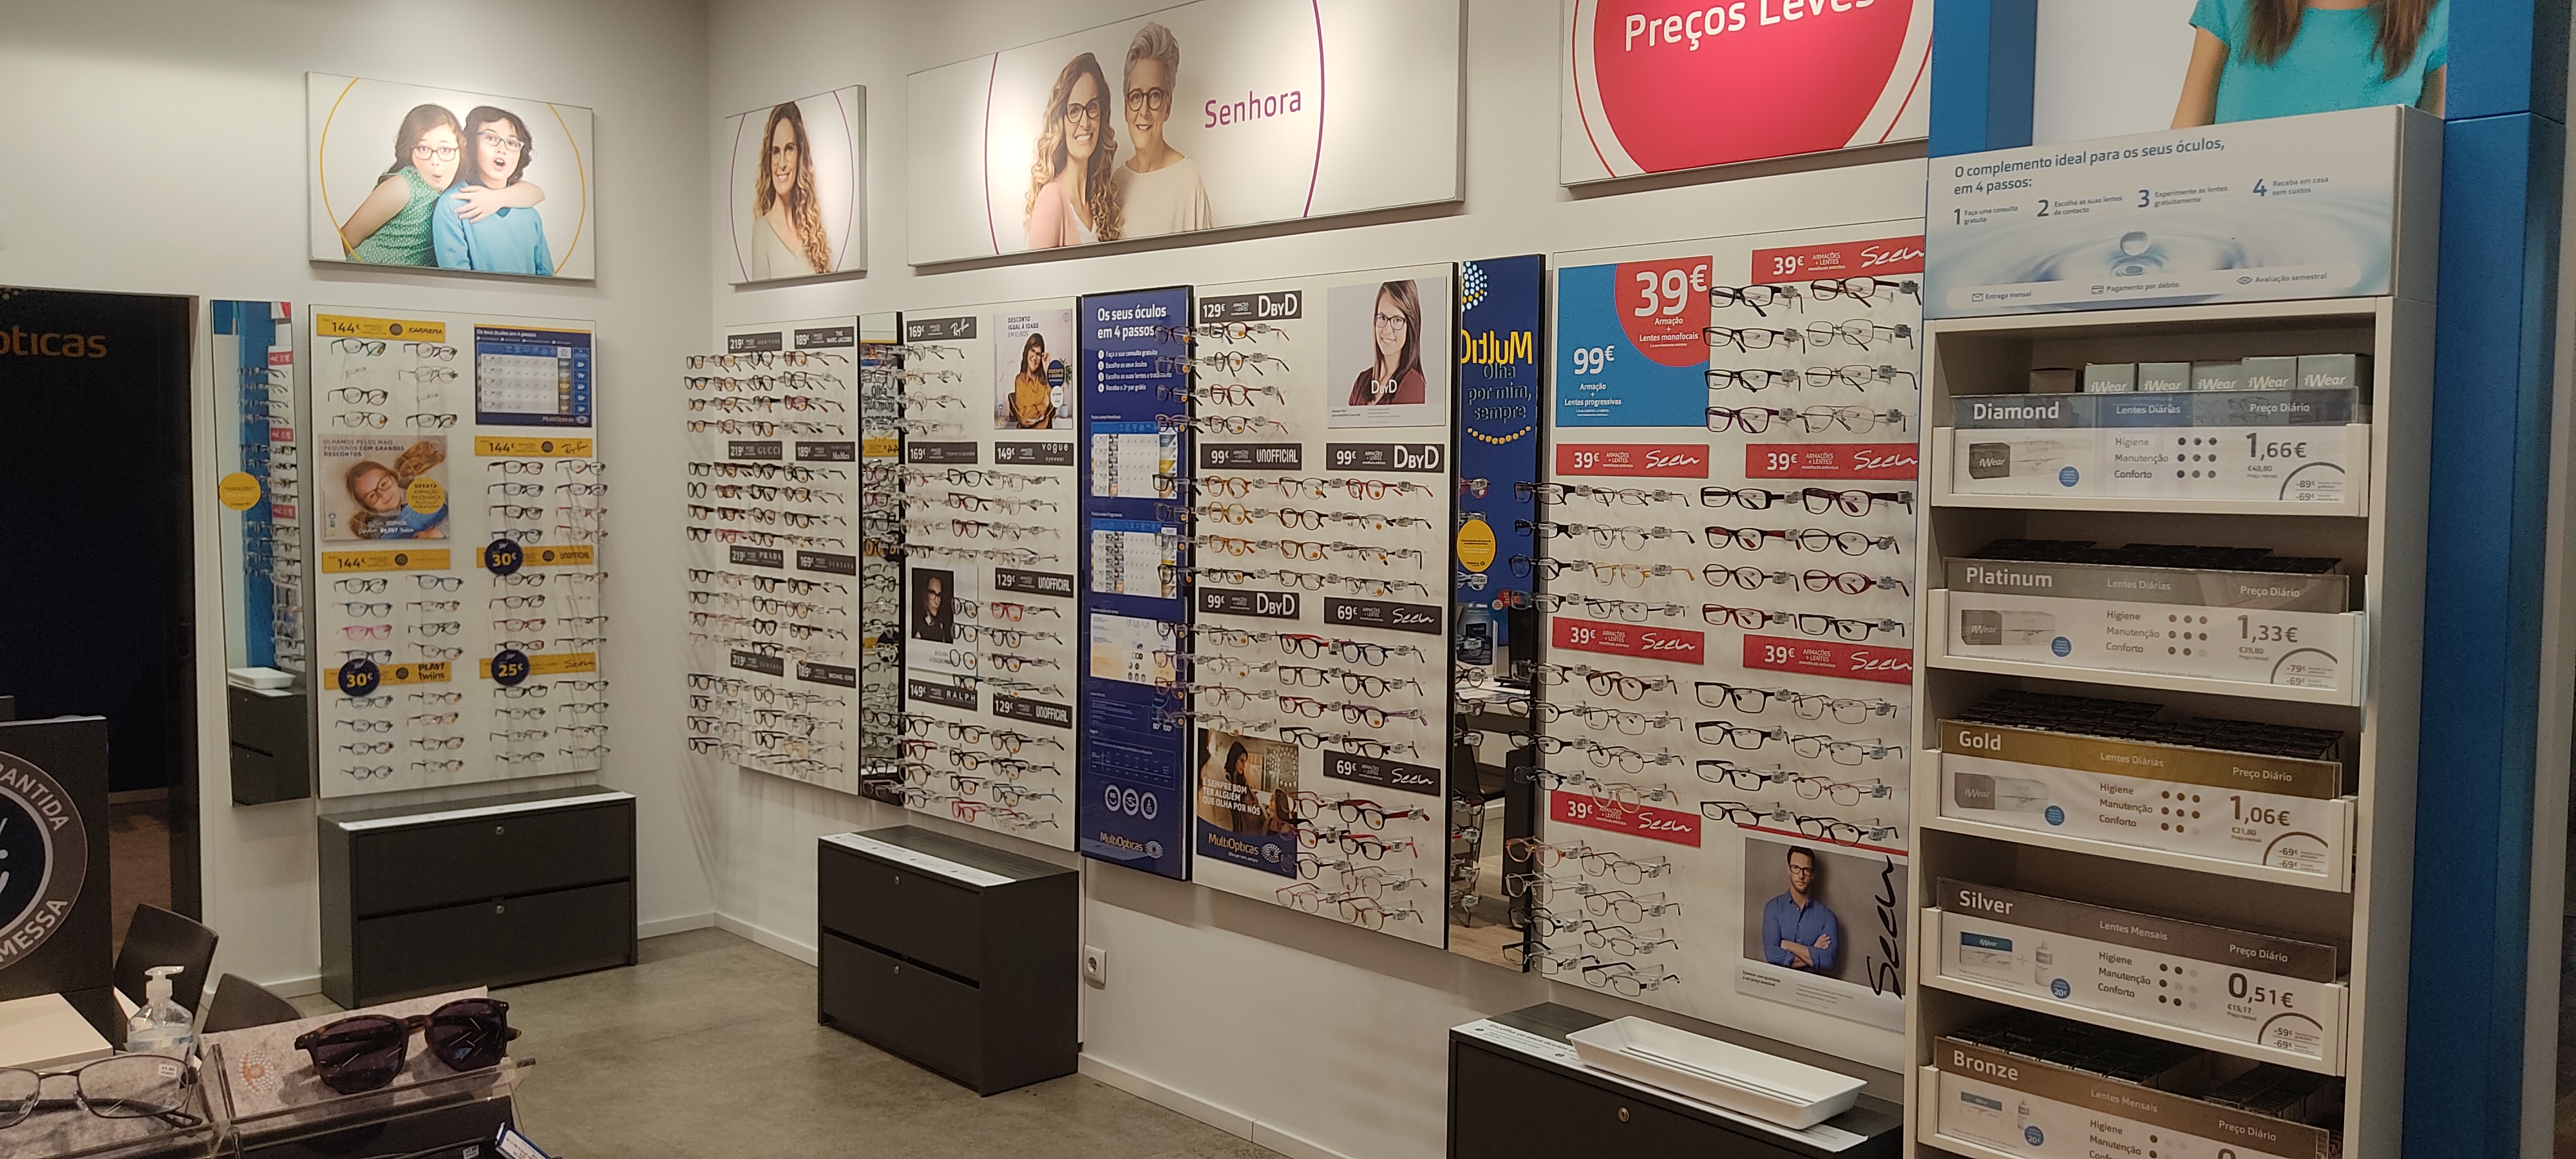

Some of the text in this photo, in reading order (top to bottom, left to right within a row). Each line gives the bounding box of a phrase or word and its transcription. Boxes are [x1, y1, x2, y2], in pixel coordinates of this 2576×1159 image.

[1625, 0, 1875, 52] Preços Lev
[1204, 90, 1302, 128] Senhora
[1955, 137, 2225, 178] O complemento ideal para os seus óculos,
[1954, 178, 2032, 194] em 4 passos:
[2155, 188, 2197, 198] Experimente
[2253, 178, 2267, 196] 4
[2138, 189, 2150, 207] 3
[2154, 196, 2201, 207] gratuitamente
[1953, 208, 1961, 225] 1
[2037, 199, 2049, 217] 2
[1964, 217, 1986, 225] gratuita
[1773, 256, 1804, 275] 39€
[2255, 272, 2327, 285] Avaliação semestral
[1634, 265, 1707, 317] 39€
[2107, 284, 2143, 293] Pagamento
[1097, 303, 1167, 321] Os seus óculos
[1203, 303, 1226, 318] 129€
[1654, 317, 1683, 326] Armação
[1097, 328, 1112, 339] em
[1114, 325, 1121, 338] 4
[1639, 332, 1698, 342] Lentes monofocais
[1573, 345, 1615, 375] 99€
[1580, 383, 1606, 391] Armação
[2144, 380, 2182, 391] iWear
[2198, 379, 2238, 390] iWear
[2248, 377, 2289, 388] iWear
[2304, 374, 2346, 386] iWear
[1468, 381, 1531, 406] por mim,
[1585, 398, 1622, 407] progressivas
[1973, 401, 2060, 420] Diamond
[2116, 404, 2181, 415] Lentes Diárias
[2250, 402, 2310, 415] Preço Diário
[1474, 406, 1526, 424] sempre
[2116, 438, 2149, 448] Higiene
[2246, 433, 2307, 461] 1,66€
[1211, 448, 1298, 464] 99€ UNOFFICIAL
[1336, 451, 1357, 465] 99€
[1574, 451, 1600, 468] 39€
[1767, 453, 1797, 471] 39€
[1979, 457, 2005, 467] iWear
[2115, 454, 2168, 464] Manutenção
[2114, 470, 2152, 479] Conforto
[1966, 567, 2053, 587] Platinum
[1338, 606, 1358, 621] 69€
[1570, 627, 1596, 644] 39€
[2237, 615, 2298, 644] 1,33€
[1765, 645, 1795, 664] 39€
[947, 690, 976, 702] RALPH
[1959, 730, 2002, 751] Gold
[2101, 752, 2164, 768] Lentes Diárias
[2233, 766, 2292, 782] Preço Diário
[1203, 787, 1241, 802] TER ALGUÉM
[1208, 779, 1232, 791] SEMPRE
[1233, 784, 1247, 795] BOM
[1202, 796, 1261, 816] QUE OLHA POR NÓS
[1567, 800, 1593, 819] 39€
[2230, 795, 2290, 826] 1,06€
[1208, 833, 1259, 855] MultiOpticas
[1959, 890, 2014, 915] Silver
[2099, 920, 2168, 940] Lentes Mensais
[2099, 952, 2132, 965] Higiene
[2230, 945, 2288, 962] Preço Diário
[2099, 967, 2151, 985] Manutenção
[2098, 983, 2135, 997] Conforto
[2228, 973, 2294, 1008] 0,51€
[1954, 1050, 2018, 1081] Bronze
[2091, 1089, 2157, 1113] Lentes Mensais
